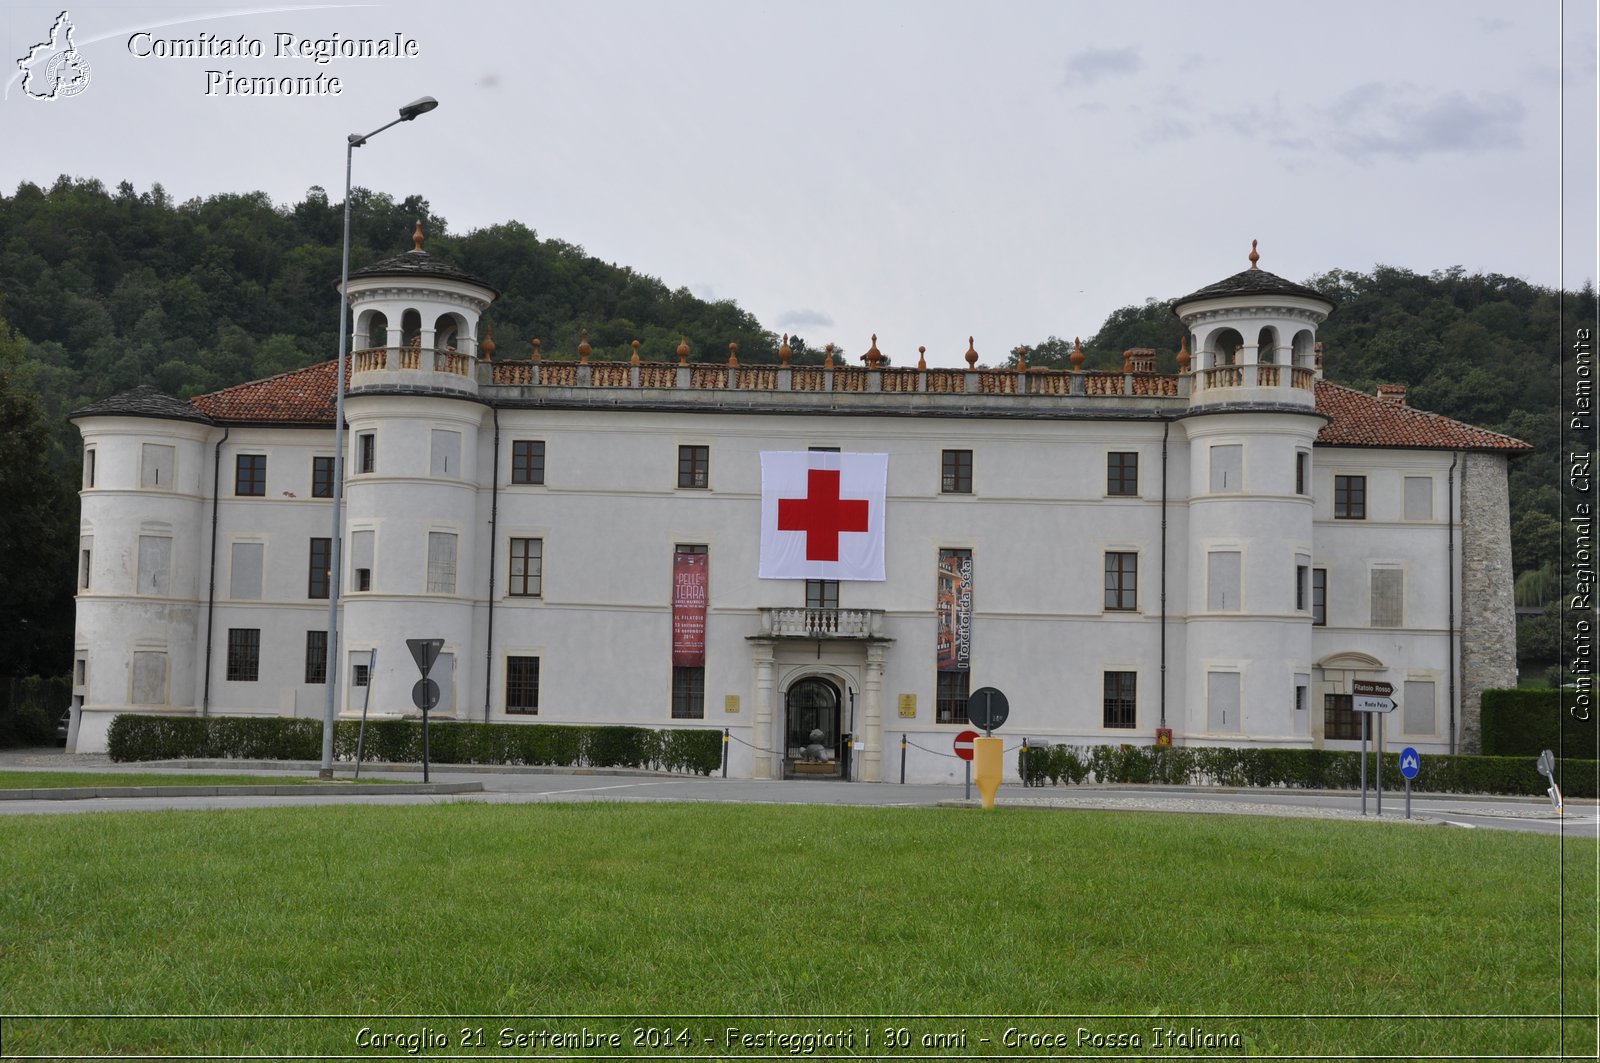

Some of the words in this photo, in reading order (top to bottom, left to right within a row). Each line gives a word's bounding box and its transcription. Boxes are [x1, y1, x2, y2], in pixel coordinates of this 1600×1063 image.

[678, 573, 700, 584] PELLE
[960, 559, 972, 589] Seta
[676, 584, 704, 600] TERRA
[960, 593, 970, 610] da
[958, 611, 970, 661] Torcitoi
